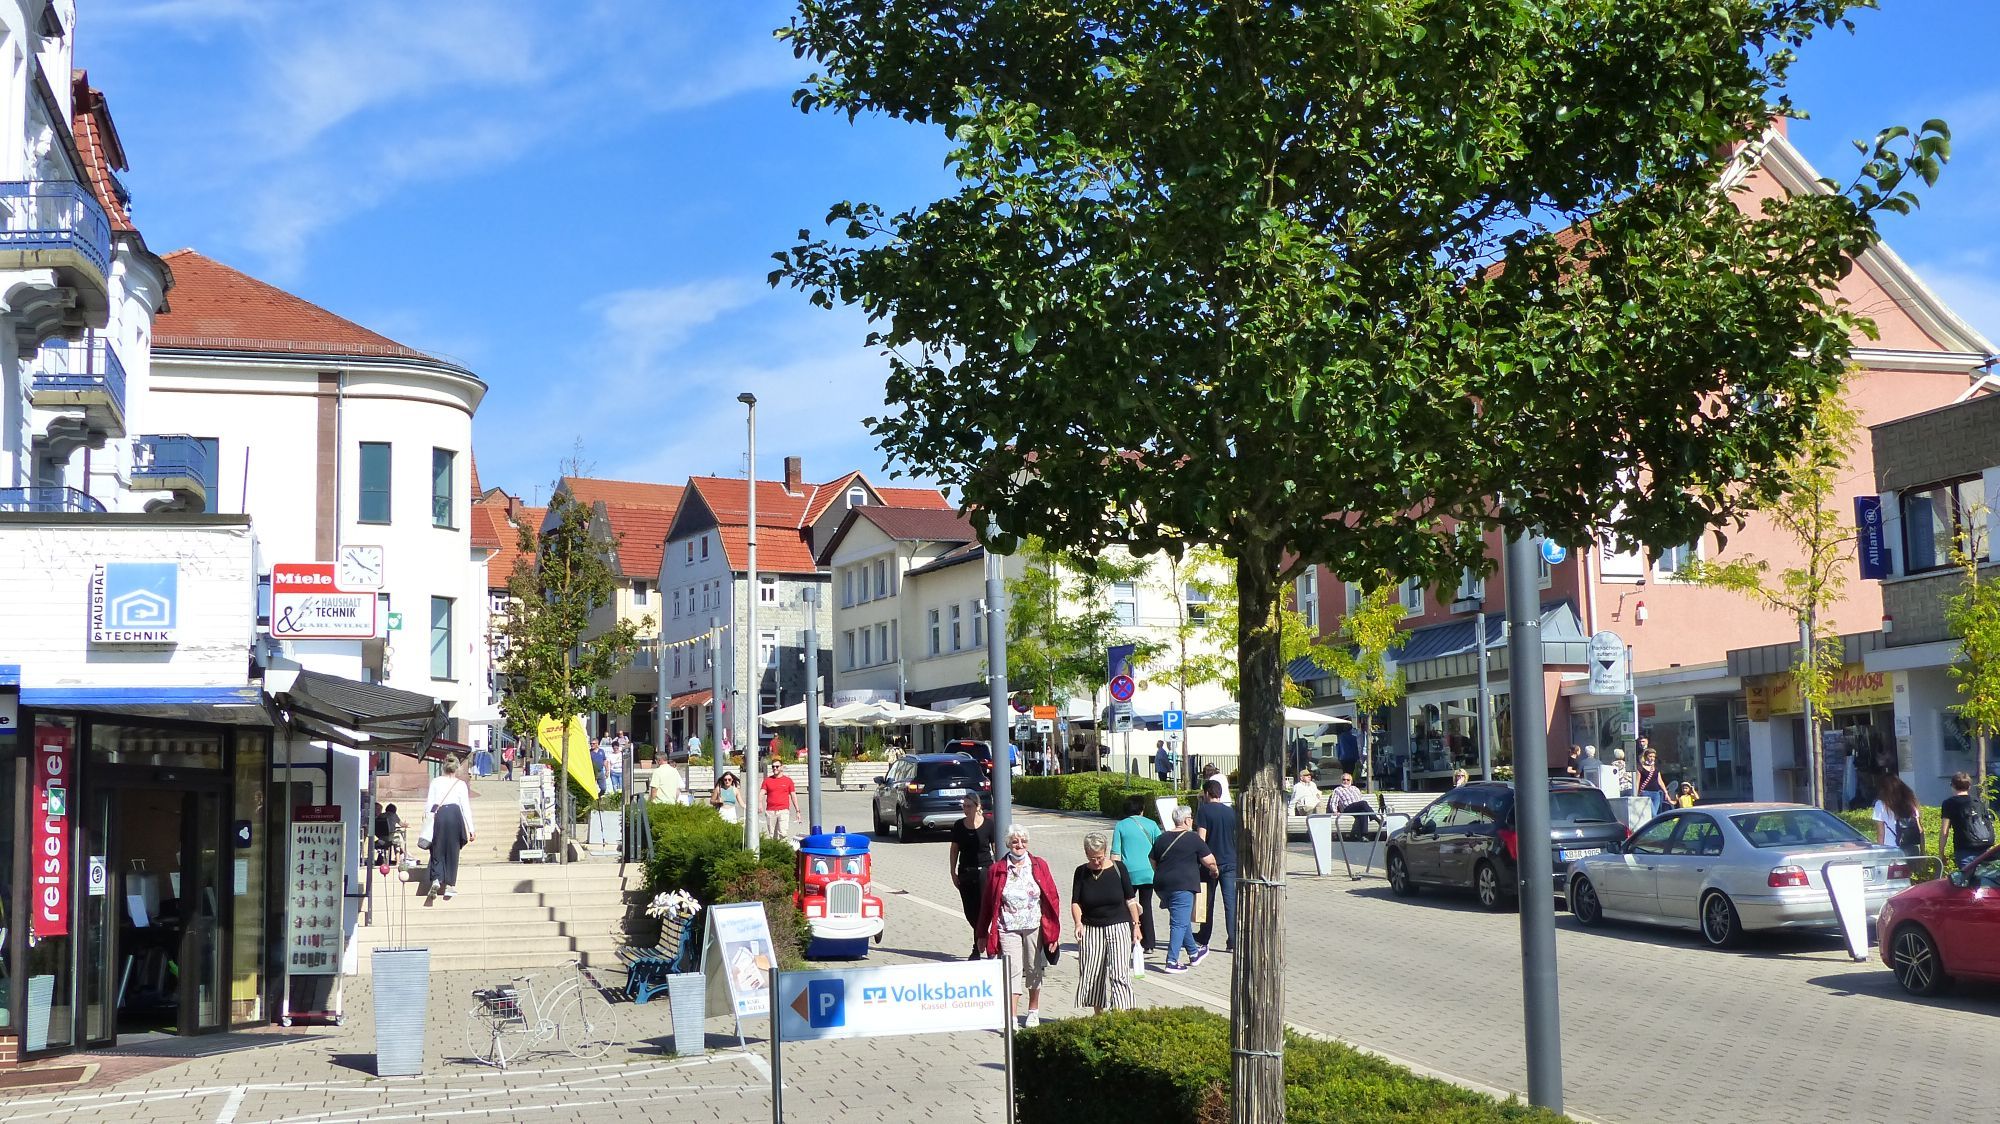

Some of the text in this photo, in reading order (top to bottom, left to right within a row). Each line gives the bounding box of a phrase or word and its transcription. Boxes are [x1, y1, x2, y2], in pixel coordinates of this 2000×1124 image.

[1869, 526, 1879, 566] Allianz
[275, 572, 333, 585] Miele
[93, 563, 104, 630] HAUSHALT
[321, 597, 362, 608] HAUSHALT
[316, 607, 356, 618] TECHNIK
[94, 632, 168, 640] & TECHNIK
[1168, 713, 1178, 728] P
[820, 979, 993, 1017] P Volksbank
[921, 999, 995, 1011] Kassel Göttingen
